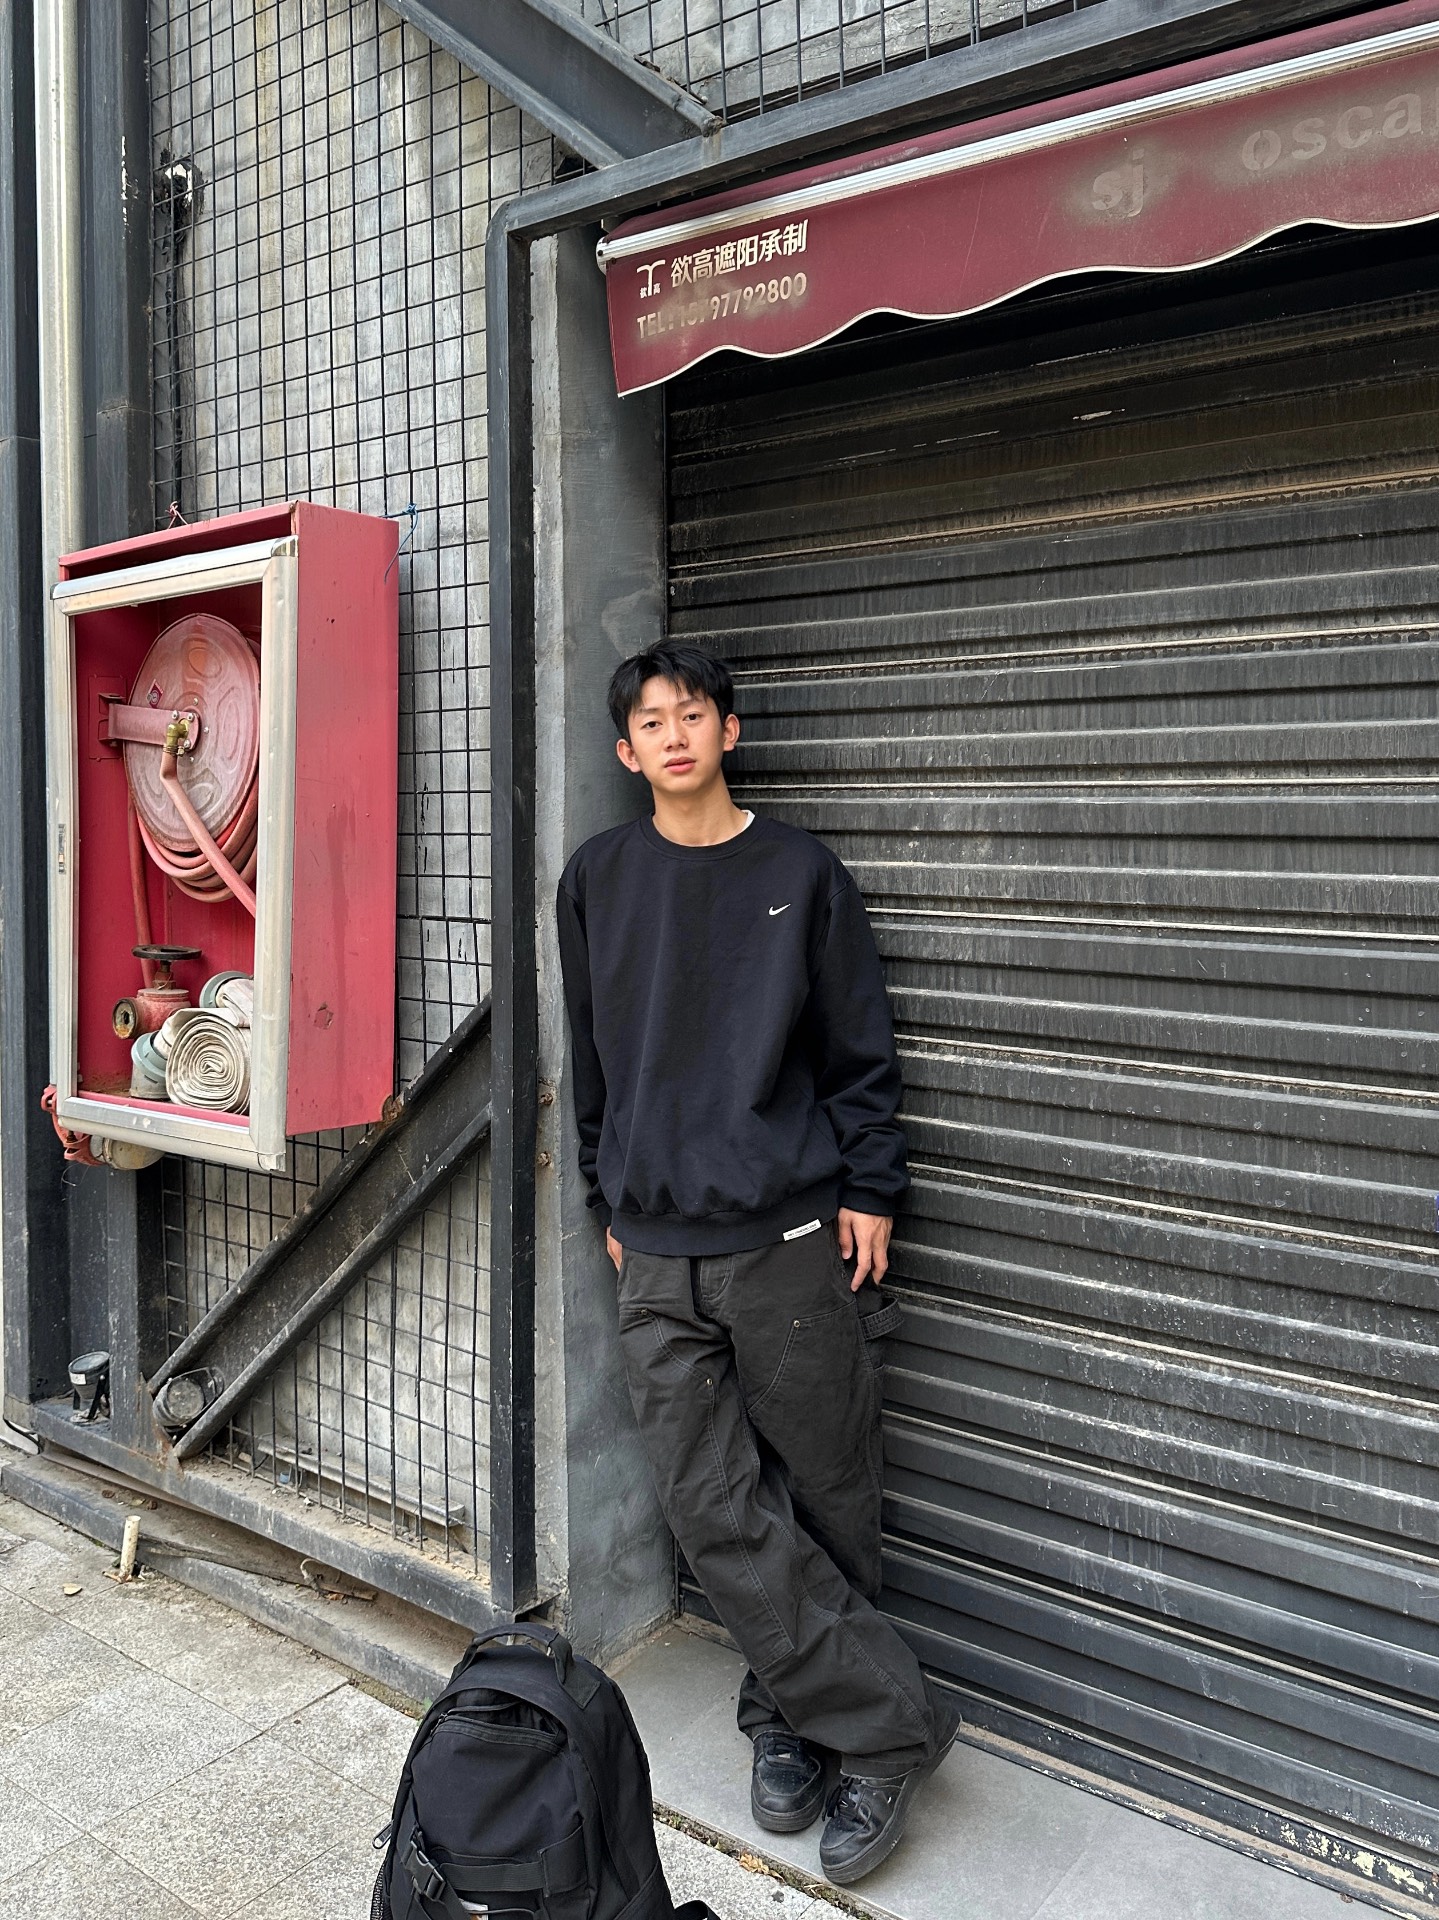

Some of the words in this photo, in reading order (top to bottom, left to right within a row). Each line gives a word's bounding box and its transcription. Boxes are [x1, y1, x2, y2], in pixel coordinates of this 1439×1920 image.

[1092, 148, 1144, 217] sj
[1241, 86, 1439, 171] osca
[671, 219, 809, 288] 欲高遮阳承制
